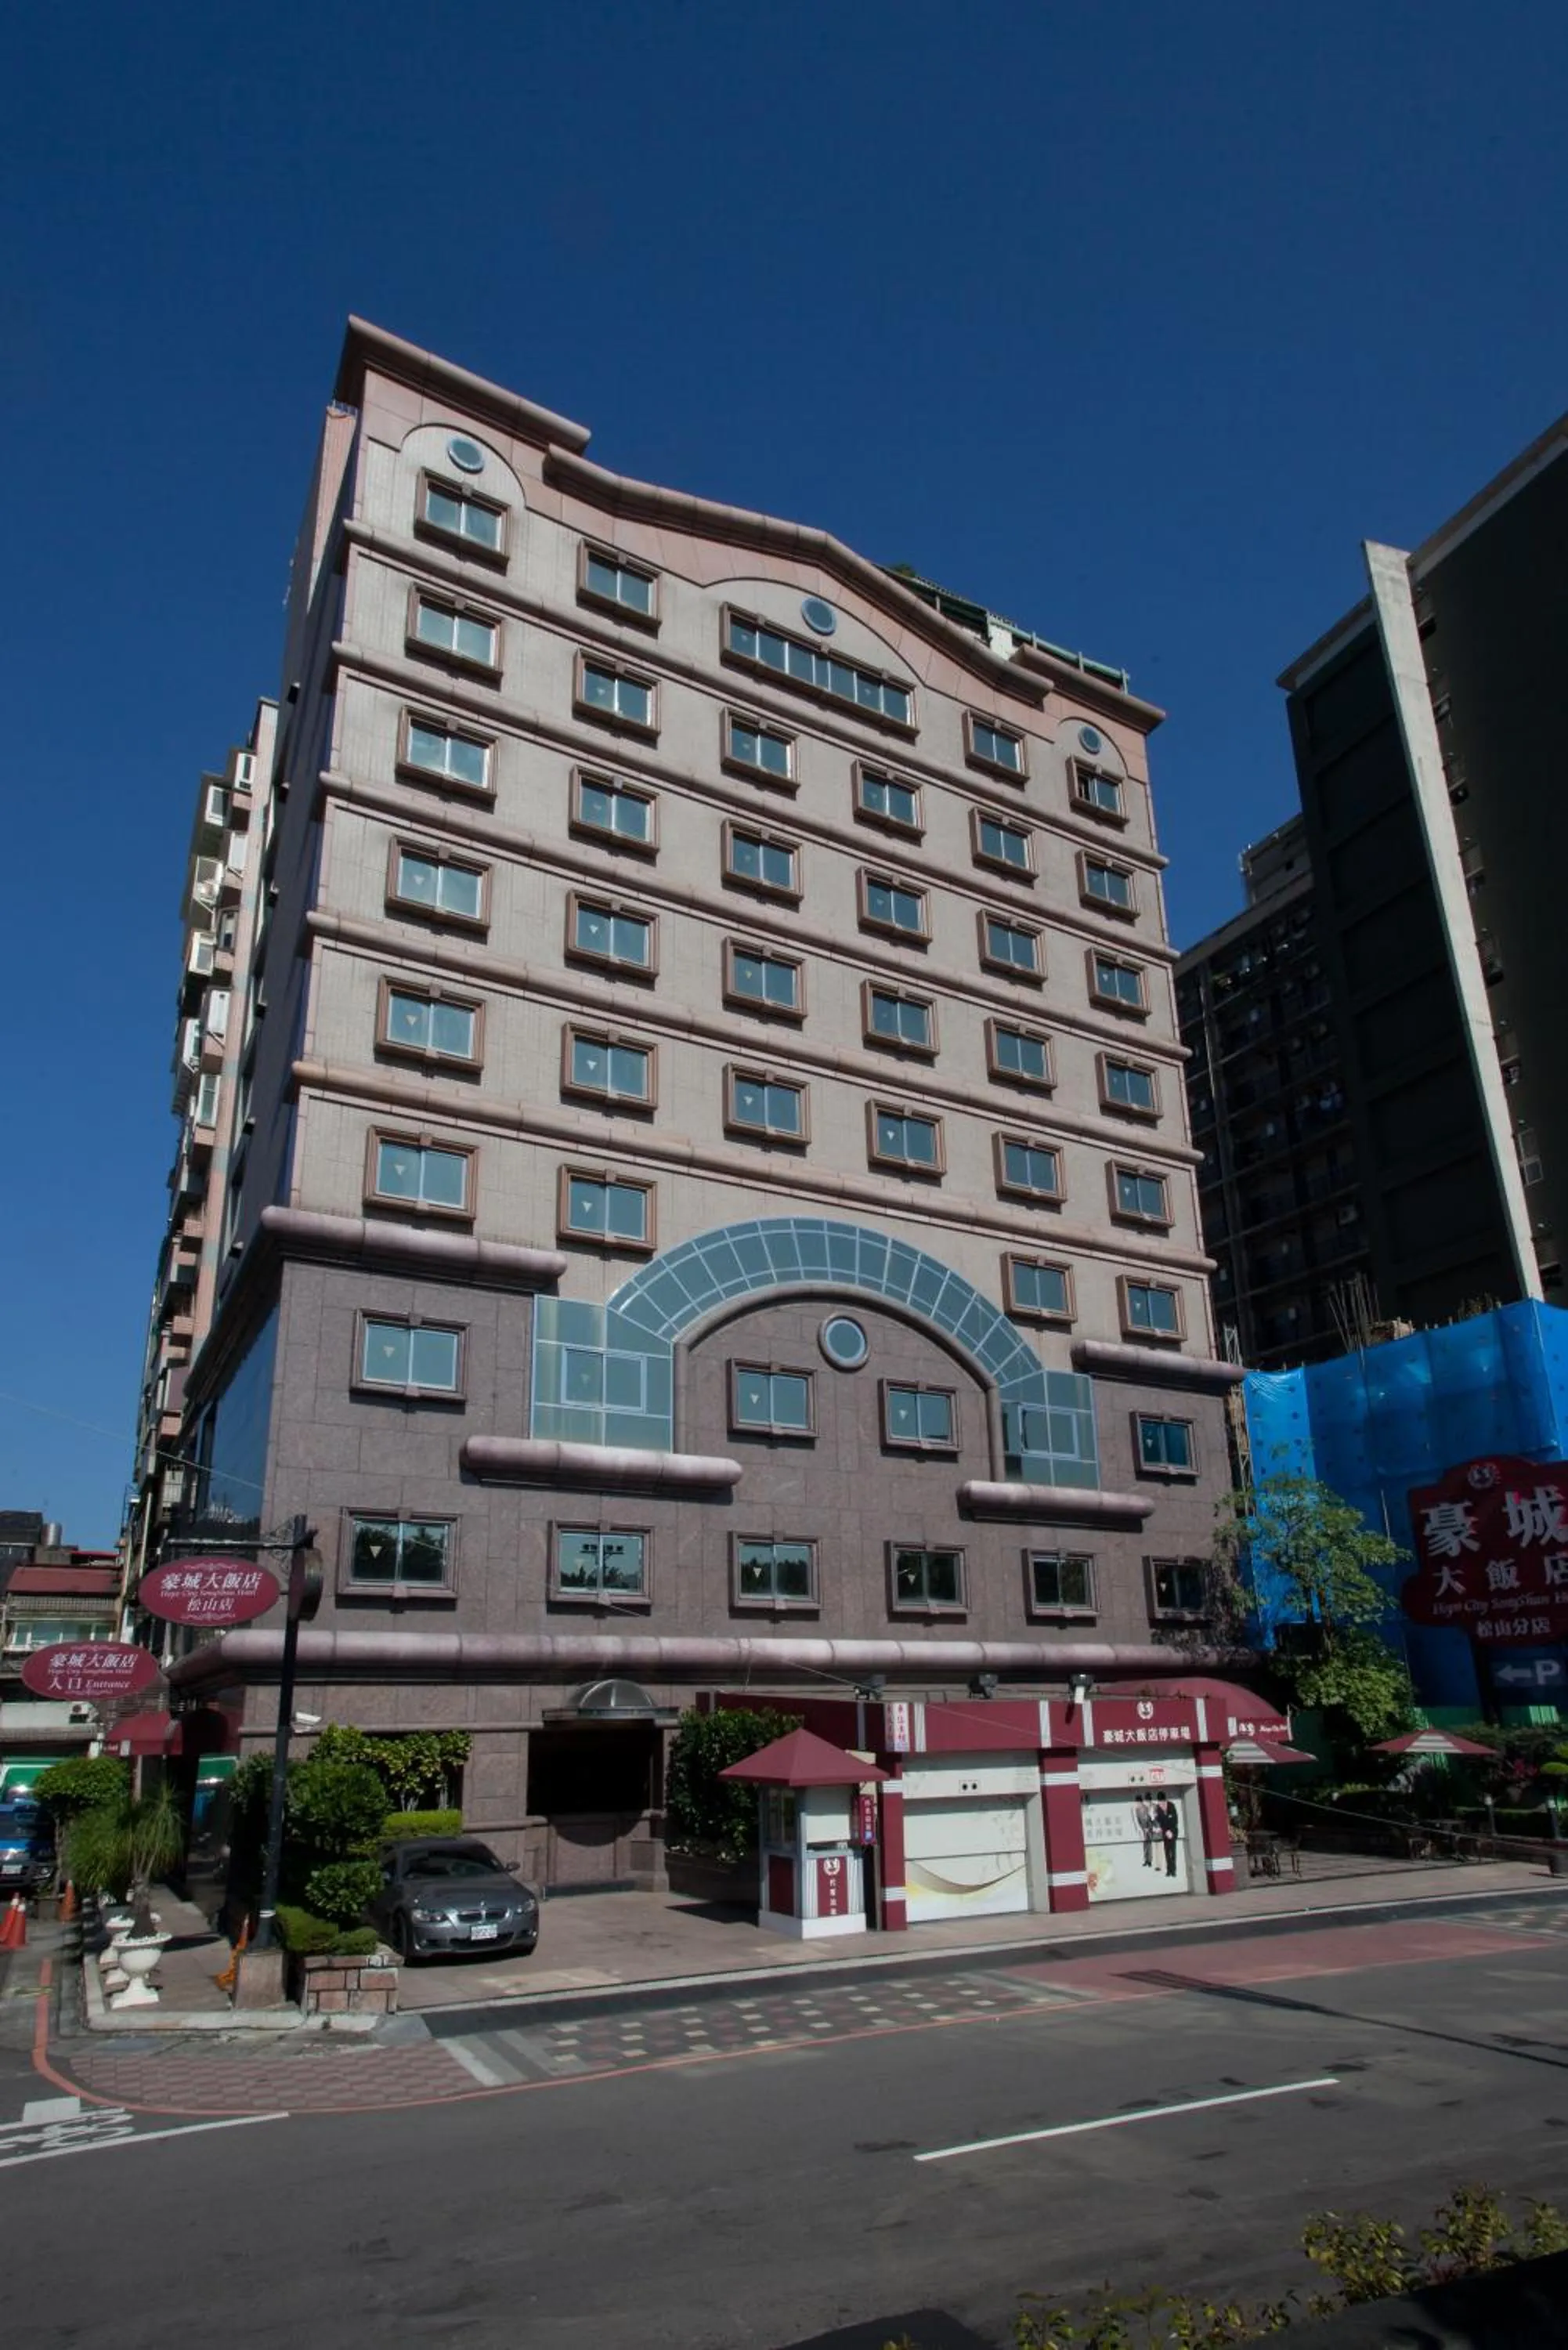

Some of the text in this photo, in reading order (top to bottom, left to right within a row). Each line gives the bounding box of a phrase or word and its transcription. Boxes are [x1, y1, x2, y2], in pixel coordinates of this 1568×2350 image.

[1420, 1484, 1568, 1557] 豪城
[1432, 1552, 1568, 1597] 大飯店
[1476, 1616, 1551, 1638] 松山分店
[48, 1676, 132, 1690] 入口 Entrance
[1534, 1658, 1561, 1686] P
